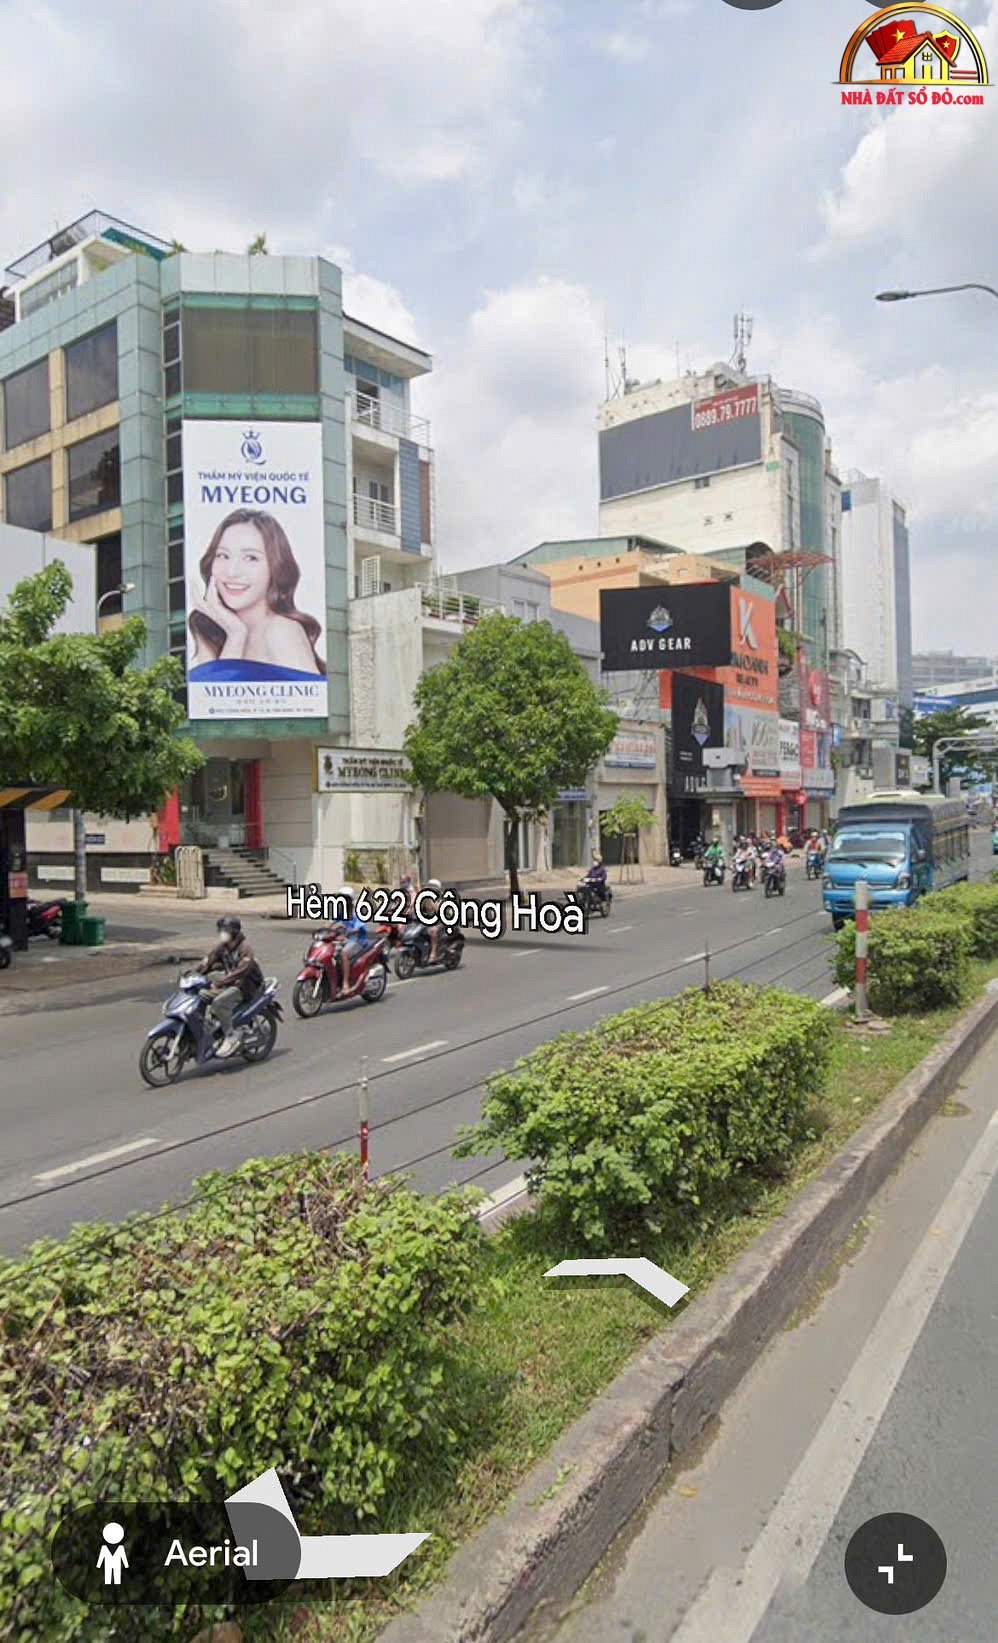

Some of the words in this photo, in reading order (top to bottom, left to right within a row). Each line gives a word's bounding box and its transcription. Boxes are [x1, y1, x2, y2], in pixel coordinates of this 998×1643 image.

[245, 471, 267, 482] VIỆN
[269, 471, 297, 481] QUỐC
[201, 485, 307, 504] MYEONG
[630, 638, 655, 652] ADV
[658, 636, 692, 651] GEAR
[204, 685, 267, 698] MYEONG
[270, 685, 319, 697] CLINIC
